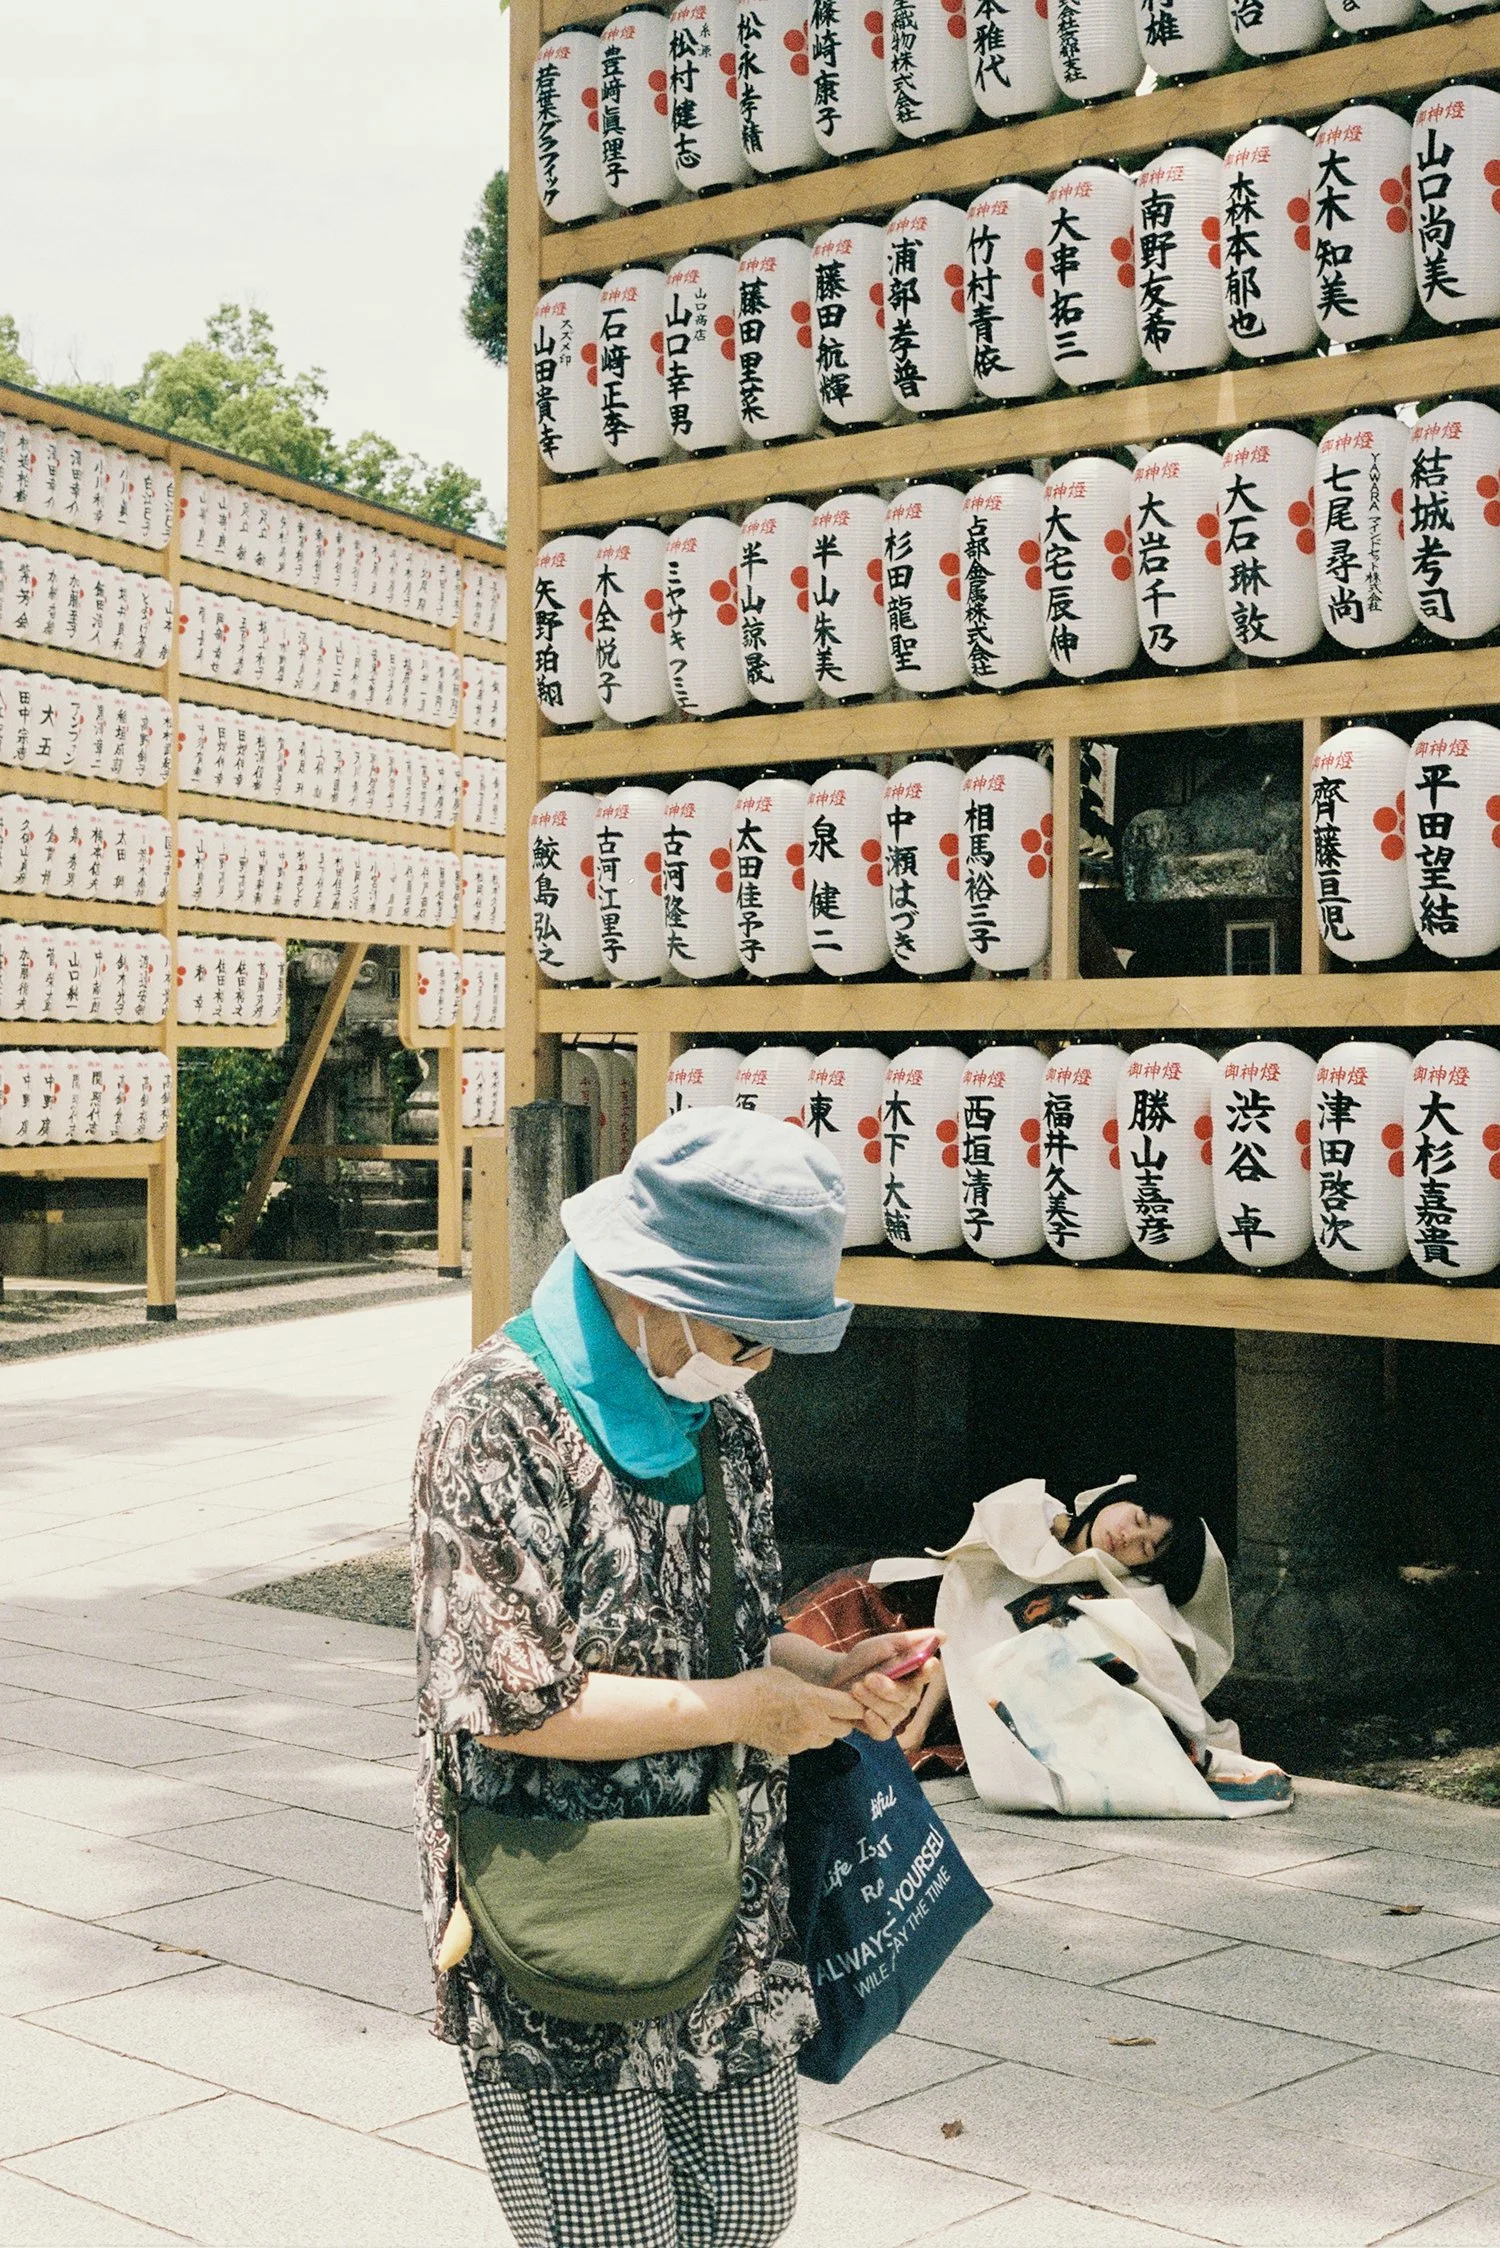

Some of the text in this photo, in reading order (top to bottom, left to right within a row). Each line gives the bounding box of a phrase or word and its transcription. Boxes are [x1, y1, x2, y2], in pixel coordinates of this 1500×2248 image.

[669, 27, 703, 170] 松村健志
[1224, 146, 1270, 168] 御神燈
[1316, 124, 1363, 146] 御神燈
[1417, 100, 1465, 125] 御神燈
[967, 201, 1009, 220] 御神燈
[1048, 182, 1092, 203] 御神燈
[1139, 166, 1184, 187] 御神燈
[1315, 149, 1359, 321] 大木知美
[1417, 129, 1467, 302] 山口尚美
[692, 288, 708, 341] 山口商店
[1048, 207, 1090, 361] 大串拓三
[1140, 189, 1177, 353] 南野友希
[1224, 171, 1267, 339] 森本郁也
[534, 325, 563, 459] 山田貴幸
[665, 293, 694, 435] 山口幸男
[738, 277, 771, 424] 藤田里菜
[815, 259, 853, 407] 藤田航輝
[1045, 482, 1086, 499] 御神燈
[1135, 463, 1180, 480] 御神燈
[1223, 445, 1270, 465] 御神燈
[1321, 431, 1374, 453] 御神燈
[1412, 420, 1462, 441] 御神燈
[963, 496, 1002, 510] 御神燈
[1137, 491, 1178, 652] 大岩千乃
[1224, 473, 1278, 644] 大石琳敦
[1323, 463, 1364, 624] 七尾尋尚
[595, 563, 624, 704] 木全悦子
[812, 534, 847, 682] 半山朱美
[884, 528, 921, 672] 杉田龍聖
[964, 515, 1000, 677] 占部金属株式会社
[1044, 504, 1082, 664] 大宅辰伸
[964, 776, 1005, 792] 御神燈
[1312, 752, 1352, 768] 御神燈
[1415, 739, 1469, 757] 御神燈
[532, 835, 565, 967] 鮫島弘之
[596, 825, 627, 964] 古河江里子
[662, 823, 697, 961] 古河隆夫
[736, 817, 767, 963] 太田佳予子
[885, 803, 920, 961] 中瀬はづき
[964, 798, 1001, 954] 相馬裕三子
[1414, 763, 1460, 937] 平田望結
[808, 1090, 840, 1138] 東
[809, 1071, 844, 1086] 御神燈
[887, 1070, 922, 1085] 御神燈
[964, 1071, 1005, 1088] 御神燈
[1047, 1068, 1092, 1086] 御神燈
[1128, 1062, 1181, 1080] 御神燈
[1225, 1062, 1280, 1082] 御神燈
[1317, 1067, 1368, 1086] 御神燈
[1414, 1066, 1469, 1087] 御神燈
[883, 1089, 915, 1243] 木下大輔
[962, 1095, 996, 1241] 西垣清子
[1044, 1091, 1082, 1247] 福井久美子
[1128, 1089, 1177, 1245] 勝山嘉彦
[1224, 1089, 1277, 1252] 渋谷卓
[1317, 1089, 1362, 1251] 津田啓次
[1412, 1090, 1463, 1267] 大杉嘉貴
[906, 1901, 930, 1931] THE
[925, 1865, 951, 1904] TIME
